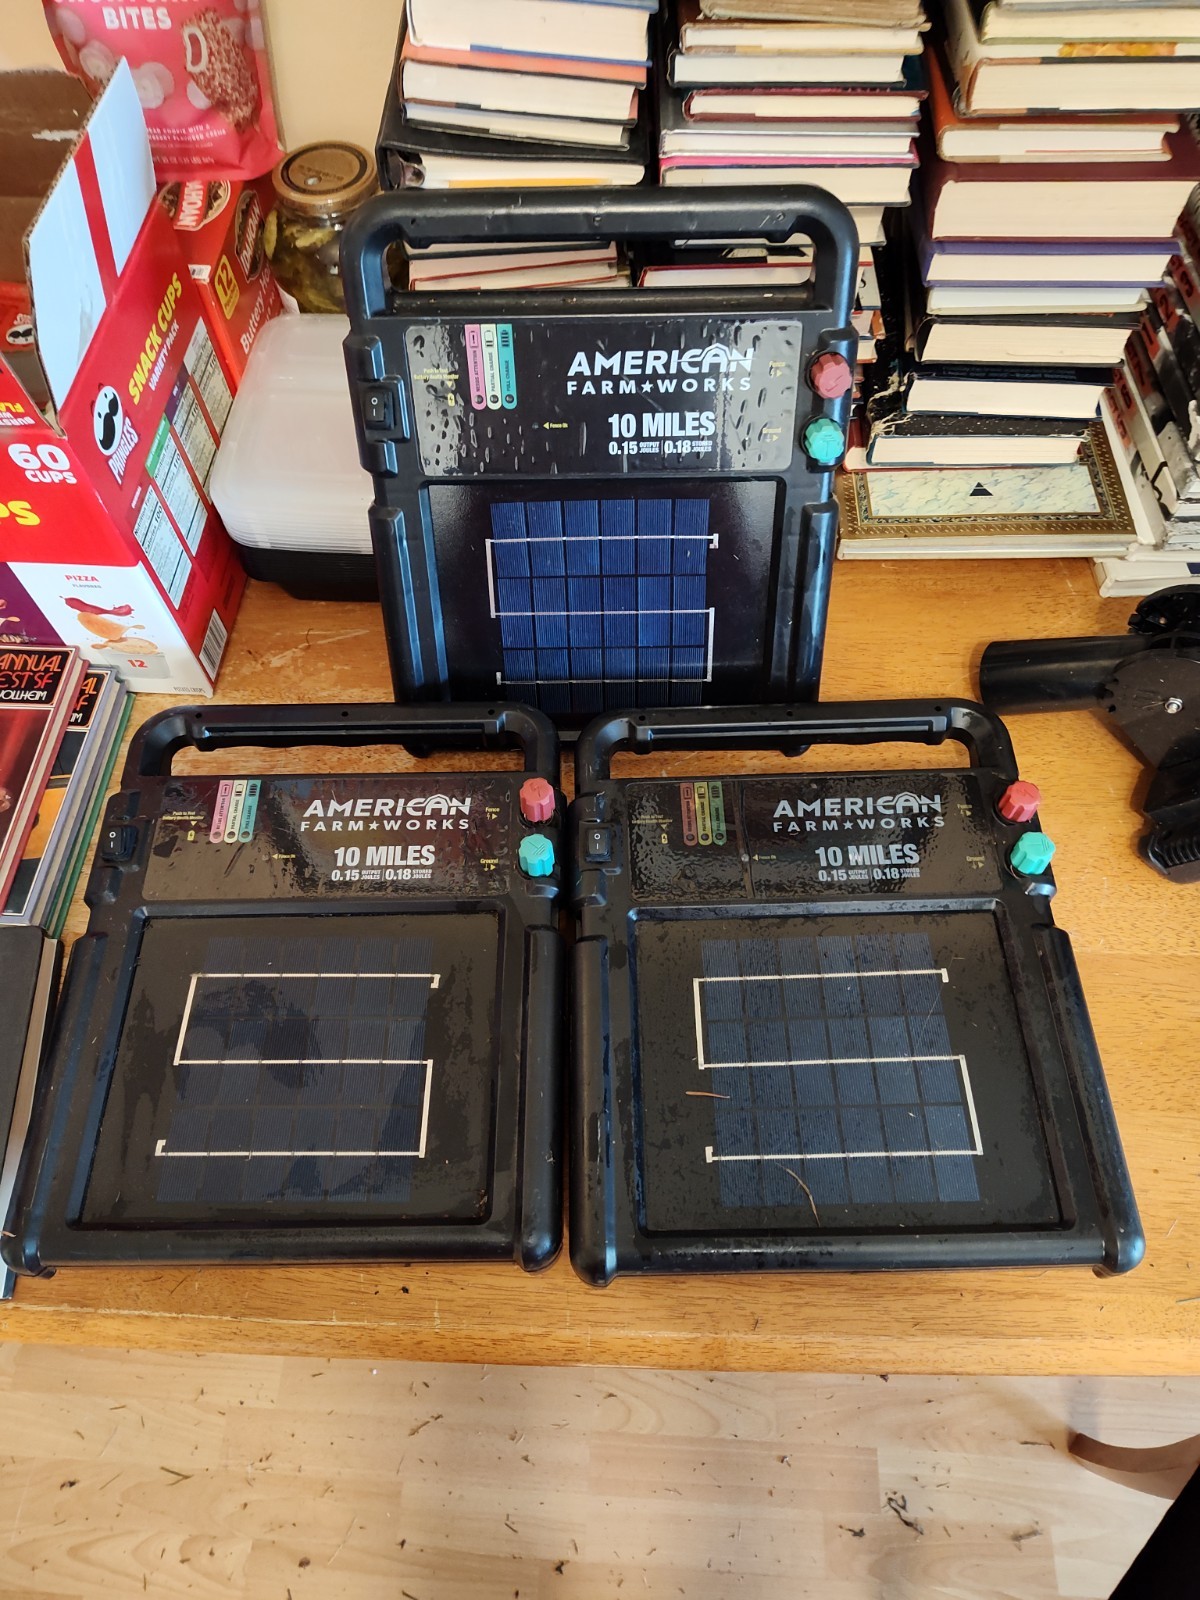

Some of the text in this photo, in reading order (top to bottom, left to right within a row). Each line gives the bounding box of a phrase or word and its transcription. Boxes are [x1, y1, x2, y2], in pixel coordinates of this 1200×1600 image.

[102, 6, 172, 30] BITES
[218, 261, 233, 299] 12
[239, 294, 265, 355] Buttery
[128, 271, 182, 406] SNACK CUPS
[148, 318, 180, 392] VARIETY PACK
[567, 342, 756, 377] AMERICAN
[566, 376, 751, 396] FARM WORKS
[191, 402, 200, 420] 110
[608, 411, 717, 439] 10 MILES
[8, 443, 71, 471] 60
[108, 415, 139, 486] PRINGLES
[608, 441, 638, 456] 0.15
[664, 440, 692, 455] 0.18
[173, 452, 182, 471] 110
[25, 469, 78, 485] CUPS
[154, 504, 164, 525] 100
[65, 575, 100, 583] PIZZA
[128, 659, 148, 669] 12
[34, 671, 54, 690] SF
[302, 793, 472, 818] AMERICAN
[772, 791, 943, 818] AMERICAN
[300, 818, 470, 832] FARM WORKS
[773, 816, 945, 833] FARM WORKS
[333, 844, 436, 867] 10 MILES
[815, 843, 921, 868] 10 MILES
[331, 869, 360, 882] 0.15
[385, 868, 412, 881] 0.18
[818, 869, 848, 882] 0.15
[873, 868, 900, 881] 0.18
